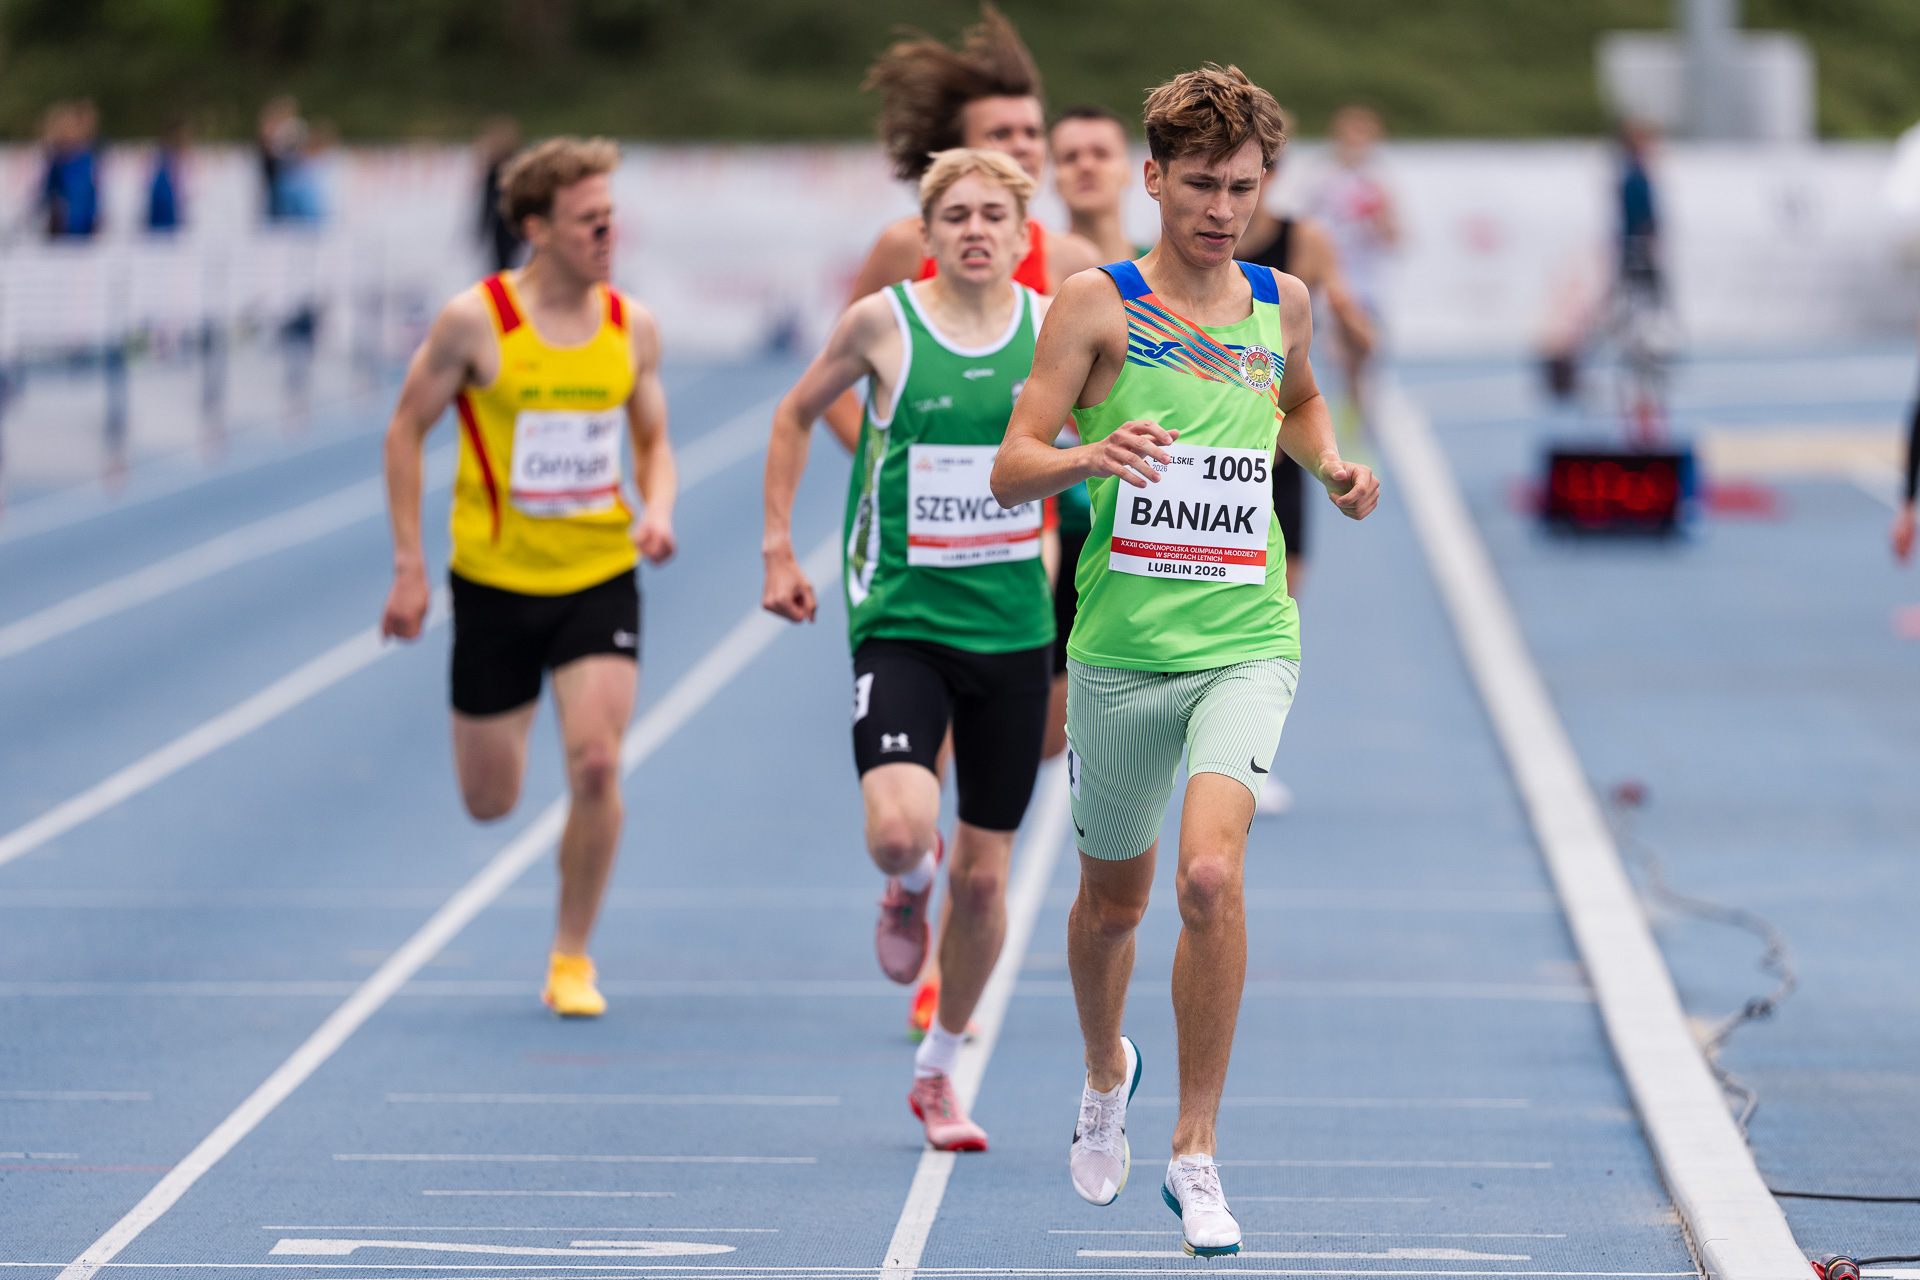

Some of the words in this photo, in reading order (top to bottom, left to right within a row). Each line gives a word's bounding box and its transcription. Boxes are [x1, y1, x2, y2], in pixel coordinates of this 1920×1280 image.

[1249, 353, 1266, 362] LZS
[1152, 464, 1168, 472] 2026
[1203, 455, 1267, 483] 1005
[1130, 496, 1258, 534] BANIAK
[1120, 539, 1138, 548] XXXII
[1138, 542, 1189, 553] OGÓLNOPOLSKA
[1190, 547, 1223, 555] OLIMPIADA
[1224, 548, 1258, 558] MŁODZIEŻY
[1163, 552, 1197, 561] SPORTACH
[1147, 562, 1192, 575] LUBLIN
[1194, 565, 1227, 577] 2026
